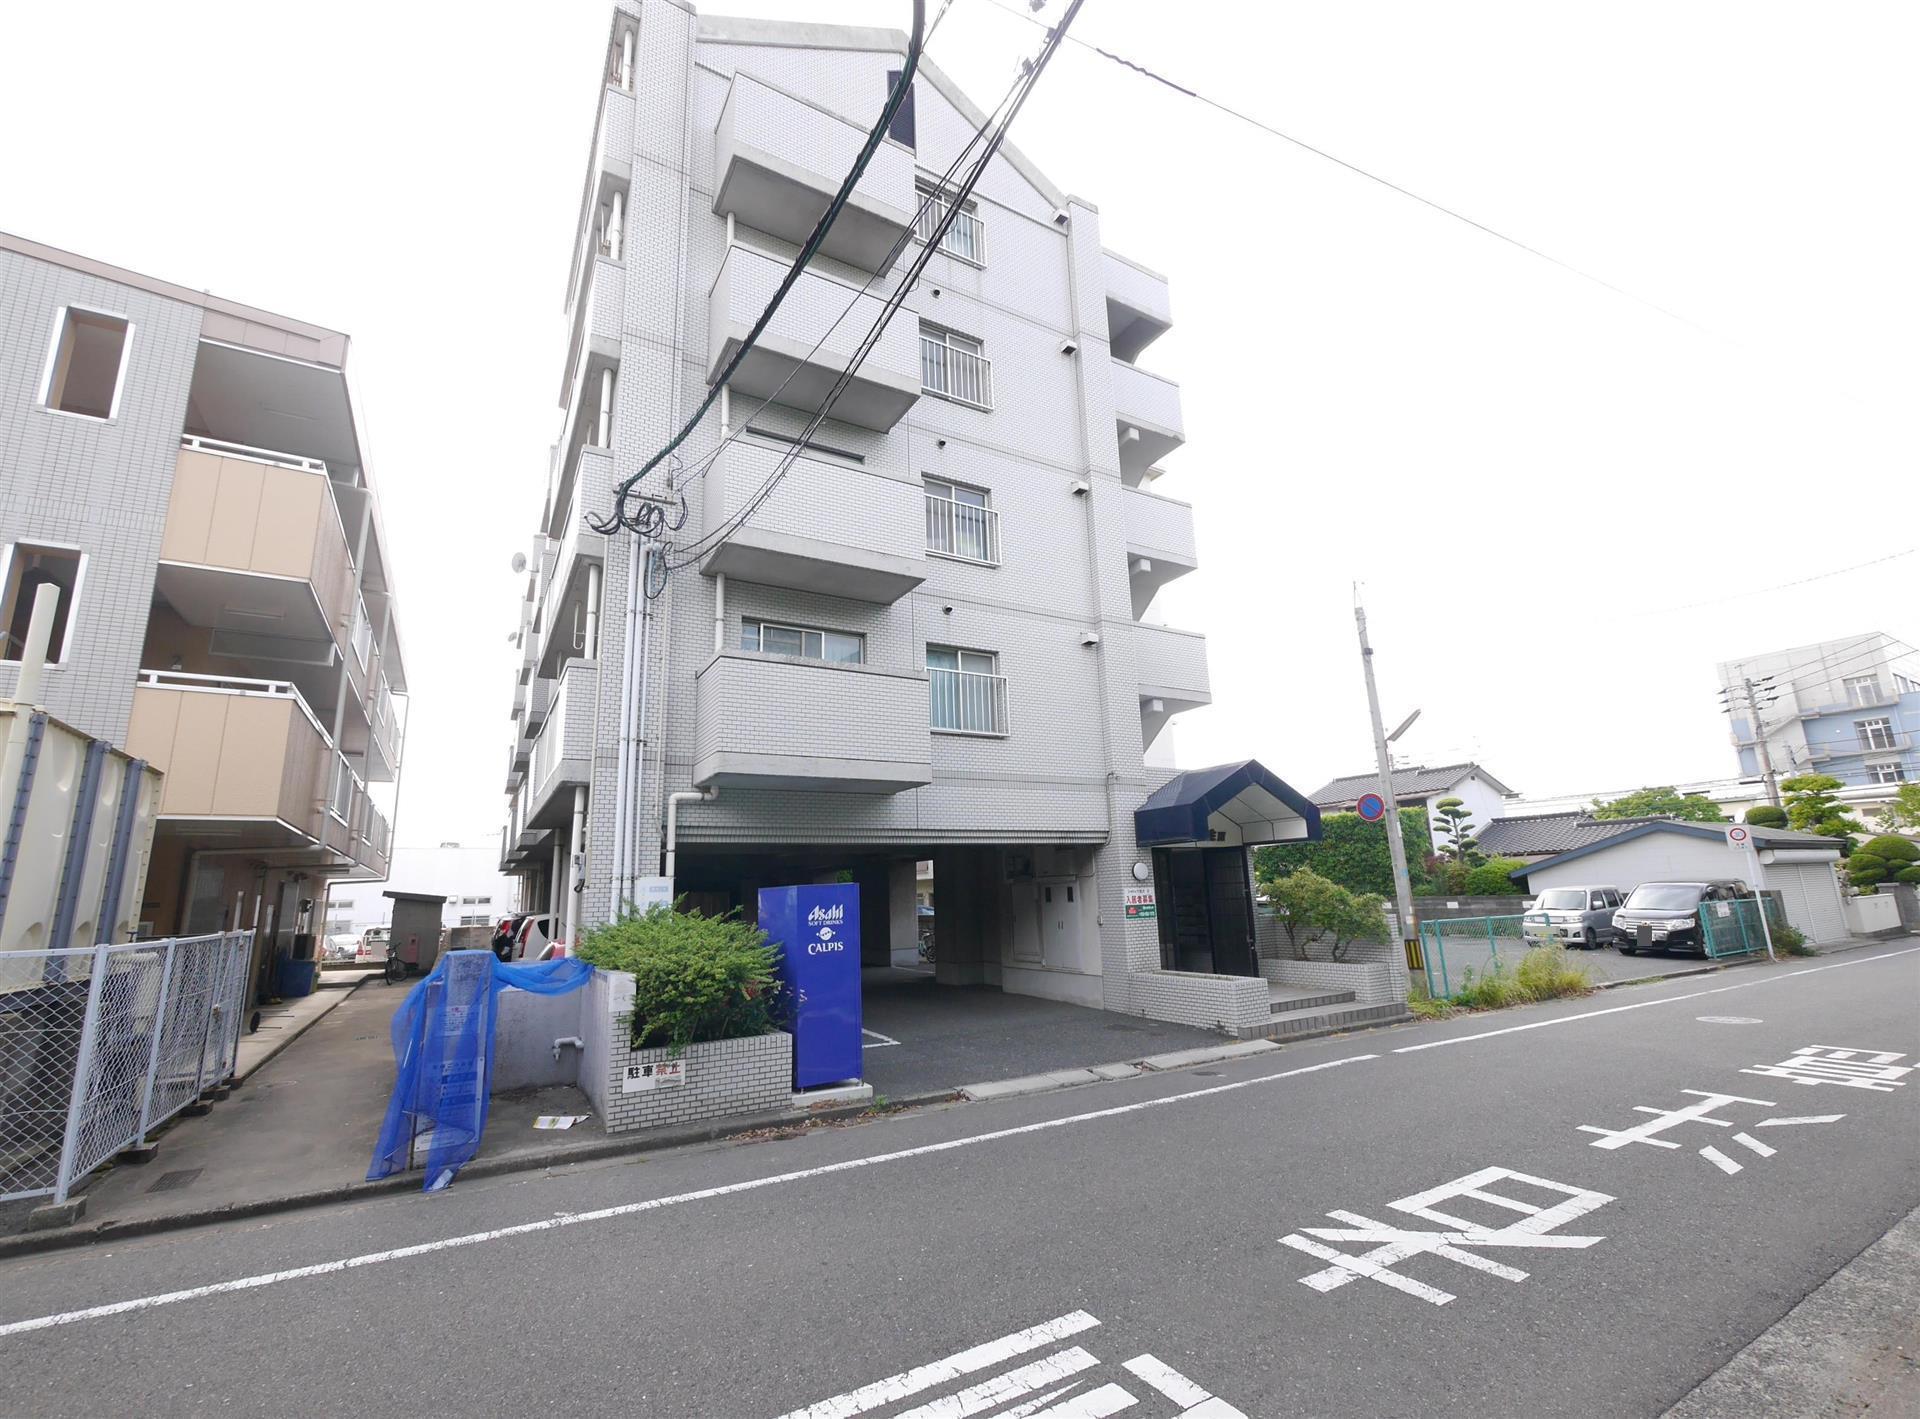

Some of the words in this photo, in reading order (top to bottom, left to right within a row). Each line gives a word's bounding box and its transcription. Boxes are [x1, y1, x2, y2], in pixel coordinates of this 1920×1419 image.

[808, 904, 844, 921] Asahi
[808, 941, 844, 955] CALPIS
[627, 1061, 681, 1079] 駐車禁止
